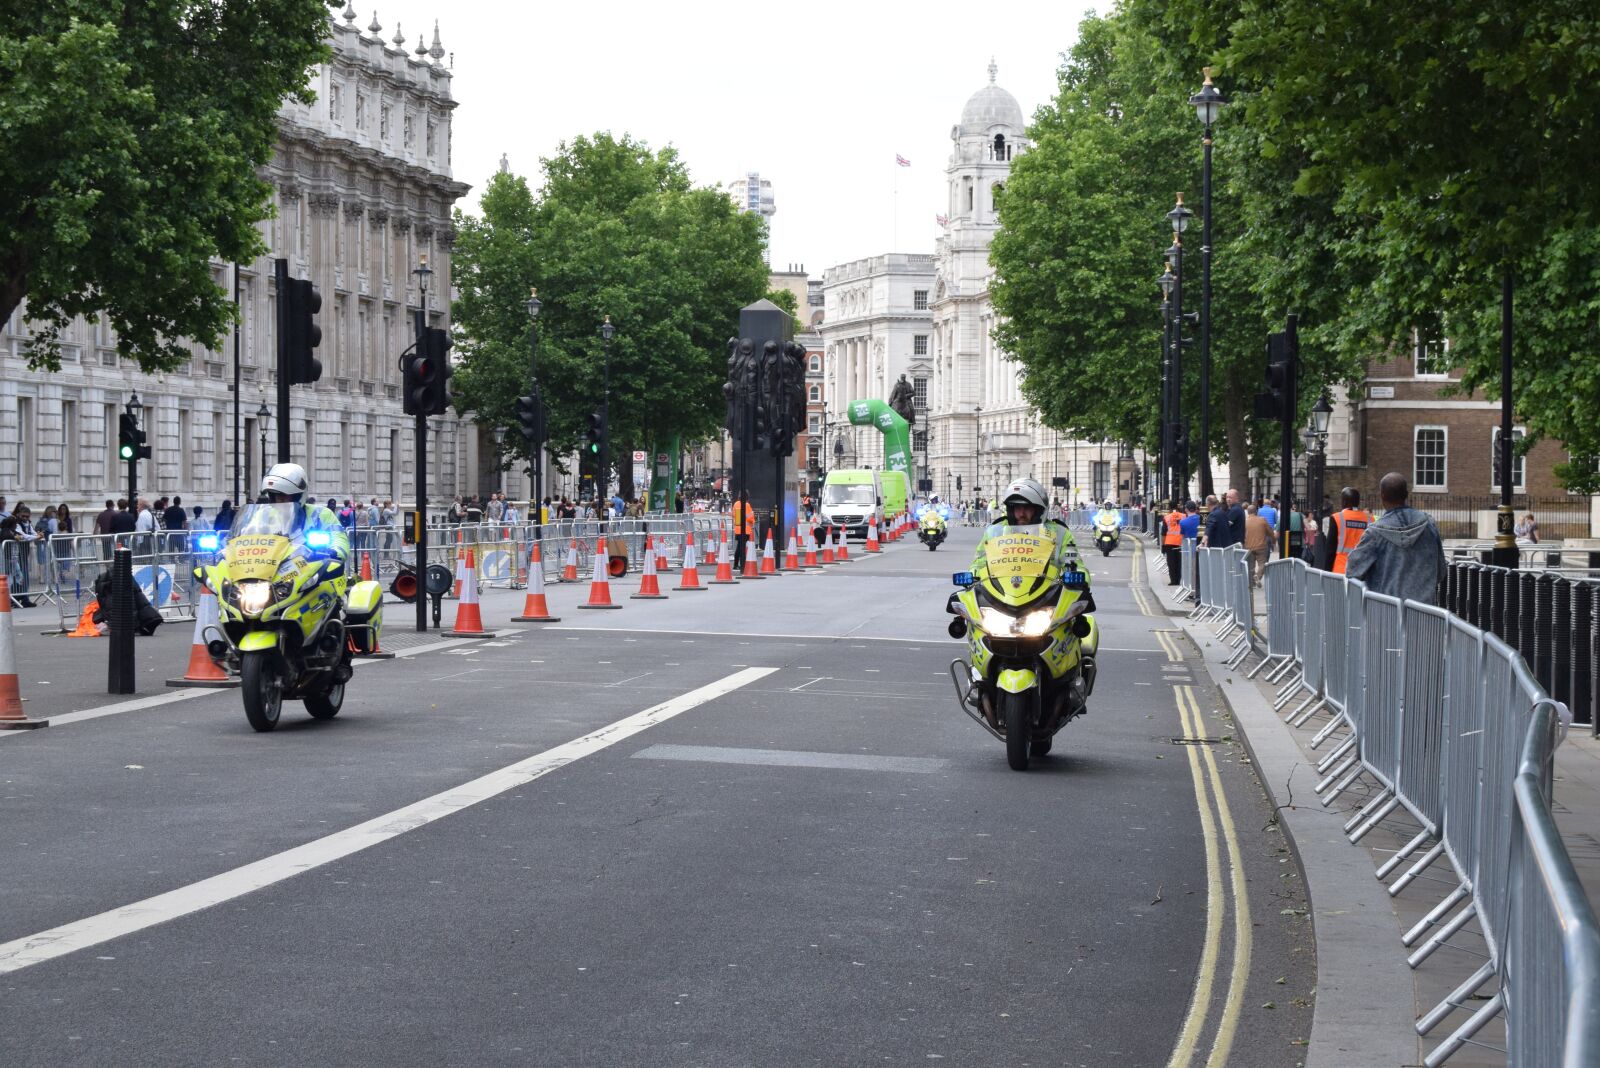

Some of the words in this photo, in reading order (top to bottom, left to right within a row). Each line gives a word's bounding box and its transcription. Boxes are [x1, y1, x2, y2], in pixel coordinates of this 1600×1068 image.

[998, 538, 1040, 546] POLICE
[239, 548, 268, 556] STOP
[229, 559, 252, 568] CYCLE
